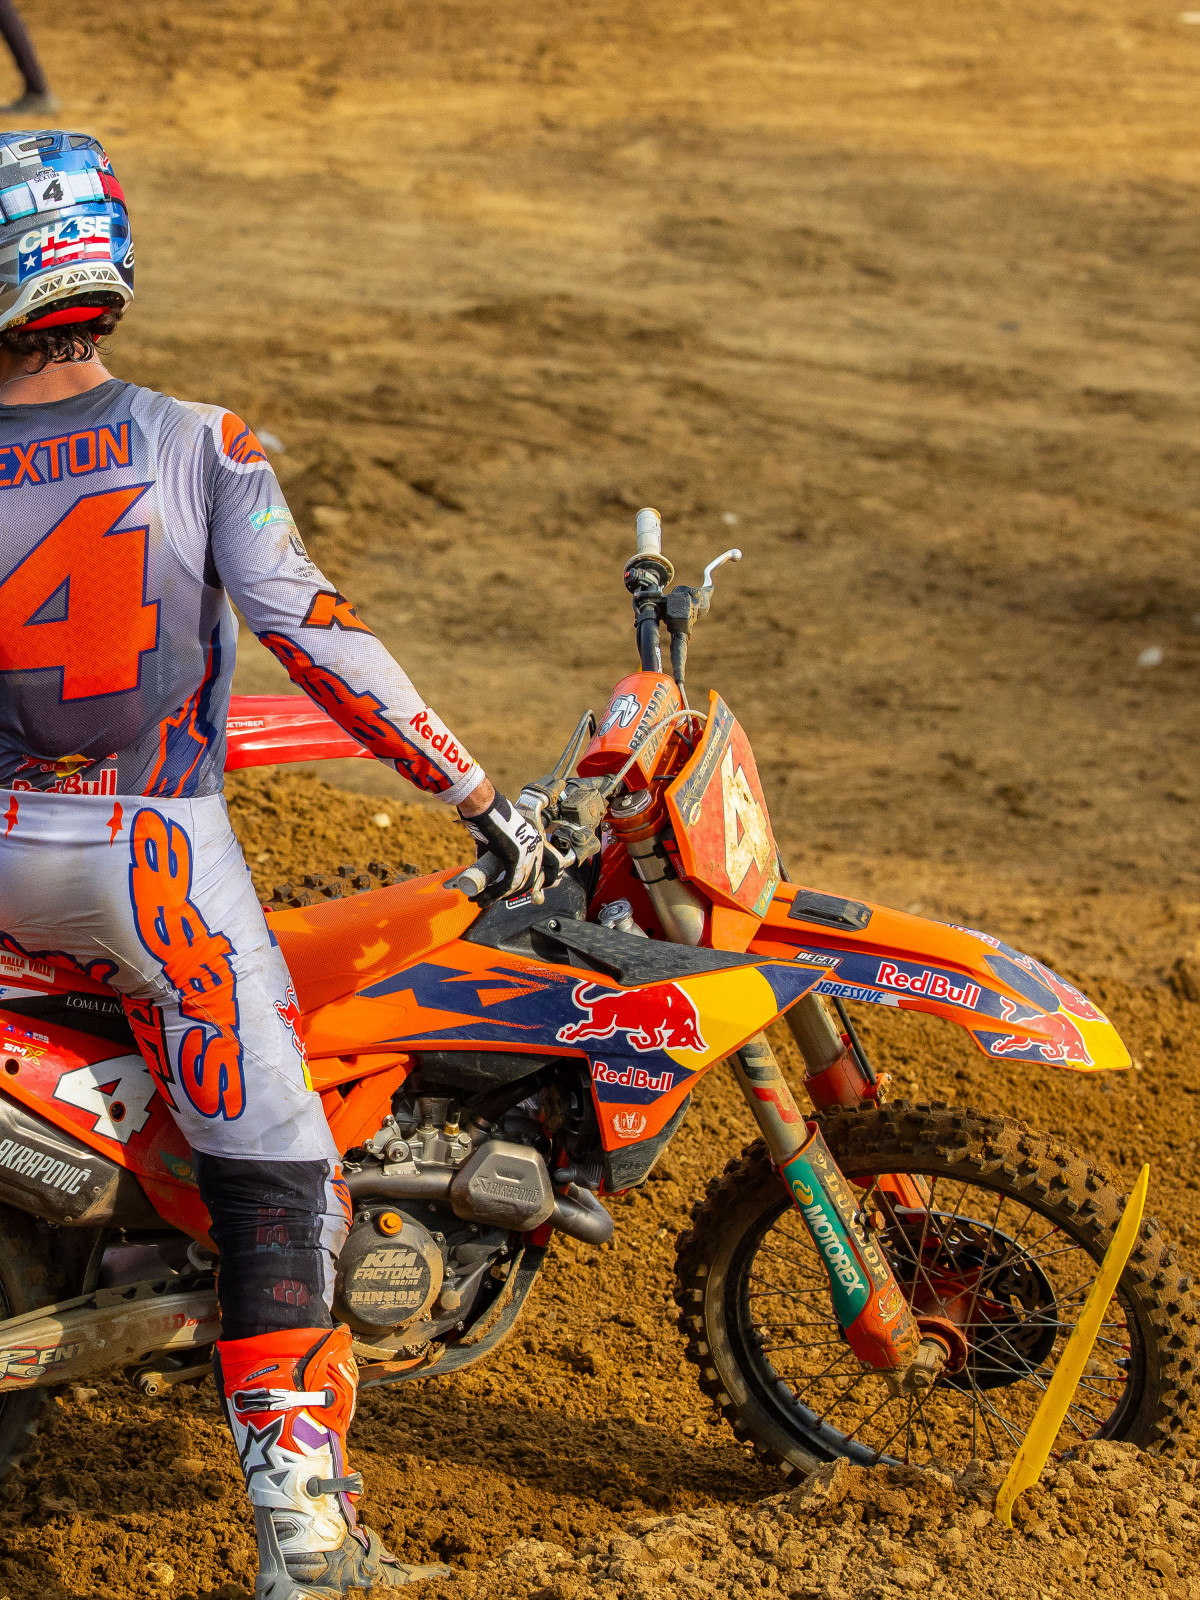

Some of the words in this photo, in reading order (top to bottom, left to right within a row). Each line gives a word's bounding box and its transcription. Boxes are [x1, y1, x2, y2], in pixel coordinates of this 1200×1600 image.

[43, 179, 64, 202] 4
[408, 710, 449, 753] Red
[442, 740, 471, 774] Bu
[720, 742, 771, 894] 4
[0, 955, 25, 969] DALLA
[875, 961, 932, 994] Red
[928, 973, 982, 1010] Bull
[66, 996, 99, 1011] LOMA
[2, 1042, 45, 1066] SMX
[593, 1061, 634, 1087] Red
[632, 1068, 674, 1092] Bull
[53, 1054, 158, 1145] 4
[361, 1249, 418, 1268] KTM
[804, 1203, 866, 1297] MOTOREX
[353, 1267, 424, 1280] FACTORY
[350, 1290, 421, 1302] HINSON
